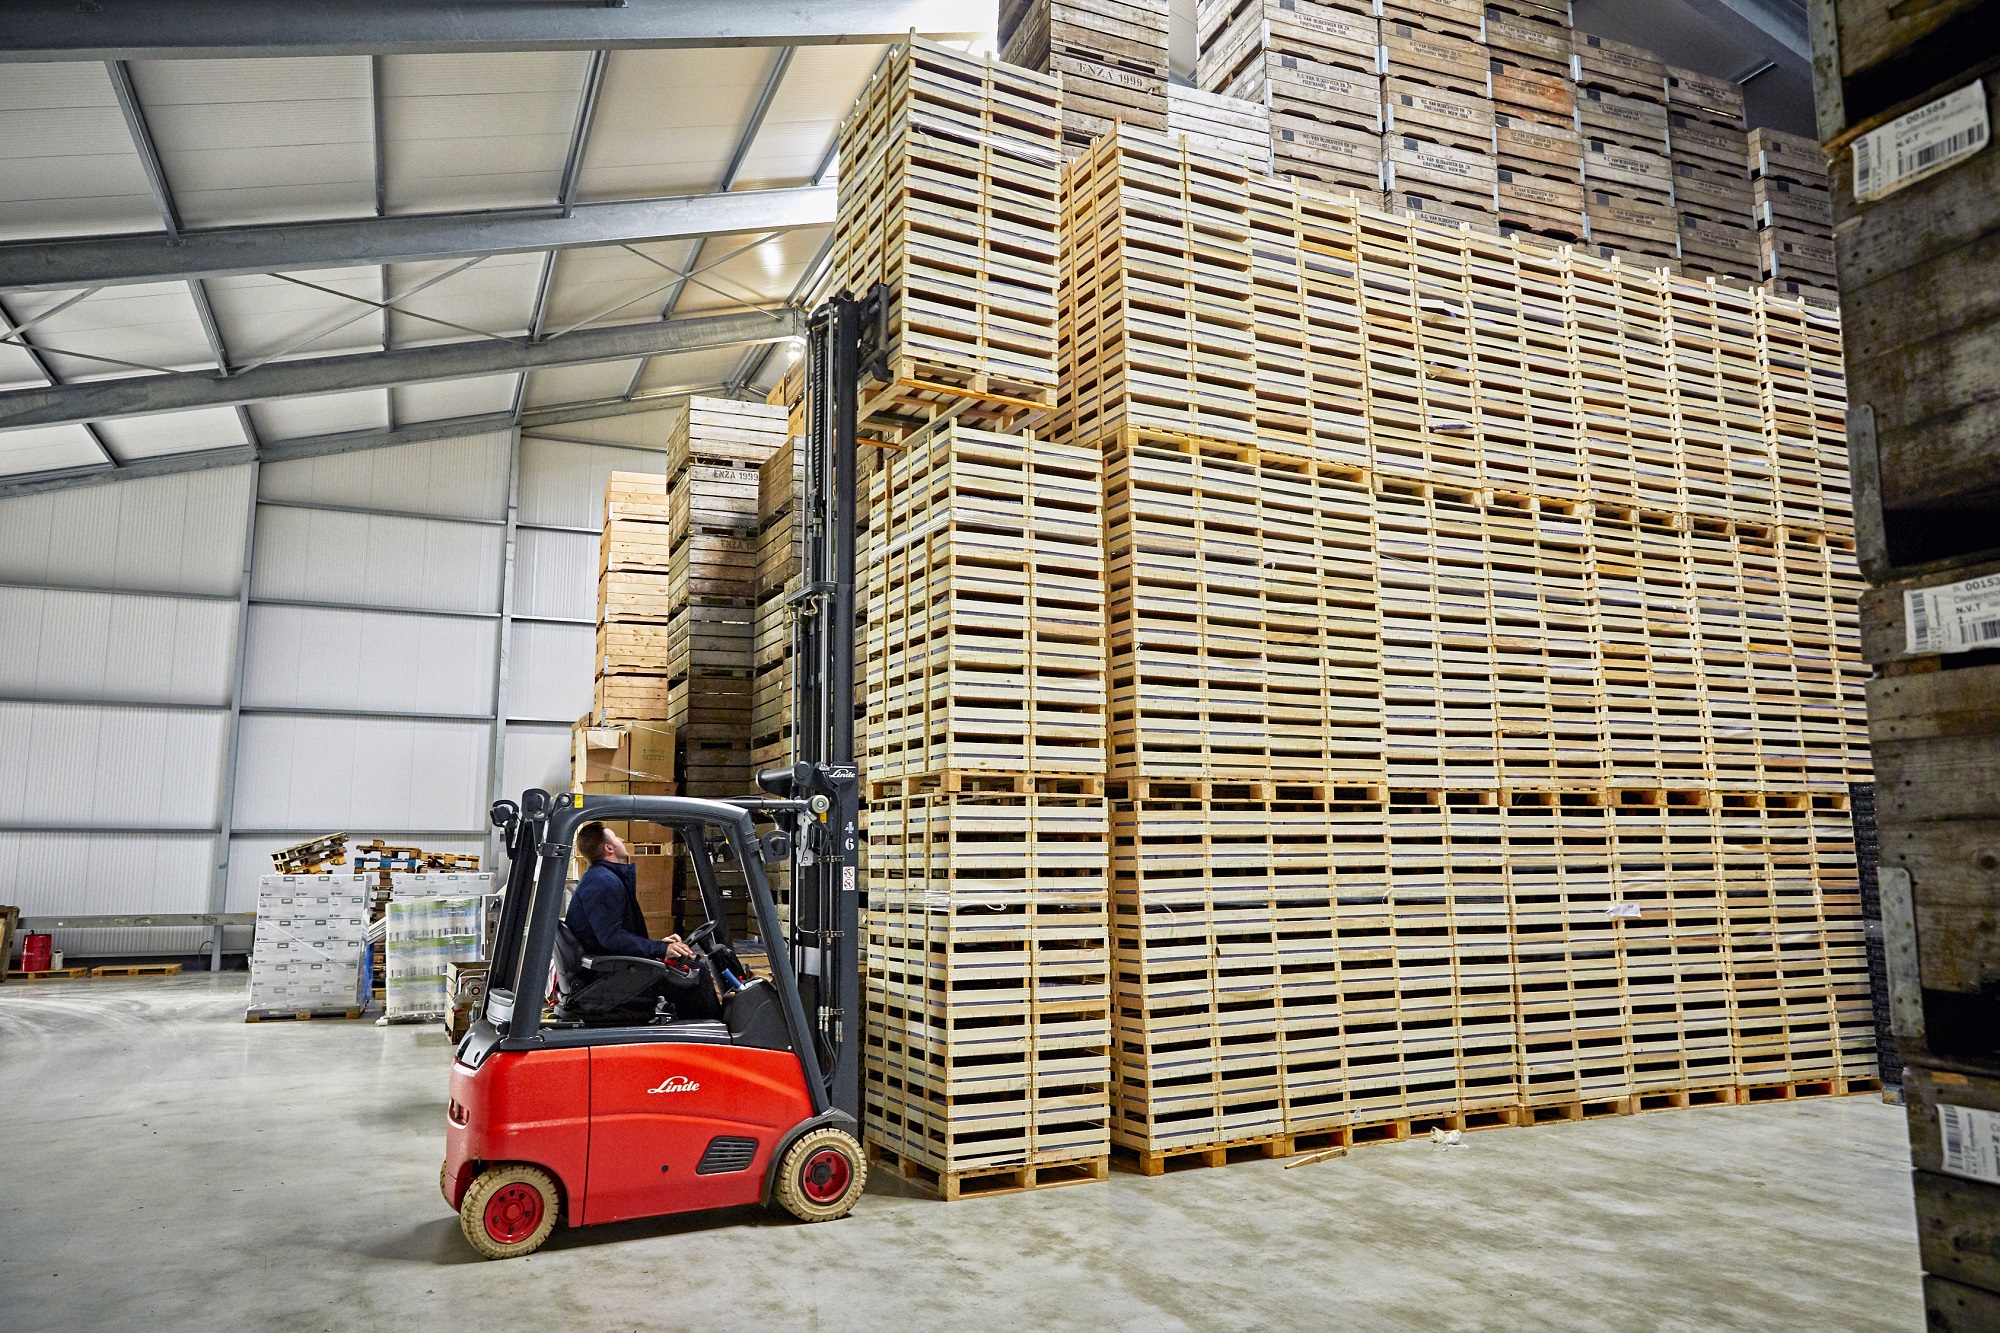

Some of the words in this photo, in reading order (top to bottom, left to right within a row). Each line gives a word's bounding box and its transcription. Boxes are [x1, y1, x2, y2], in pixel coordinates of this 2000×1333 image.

[1077, 62, 1114, 80] ENZA
[1118, 74, 1143, 87] 1999
[713, 470, 736, 479] ENZA
[738, 472, 759, 480] 1999
[828, 769, 855, 778] Linde
[647, 1075, 700, 1093] Linde
